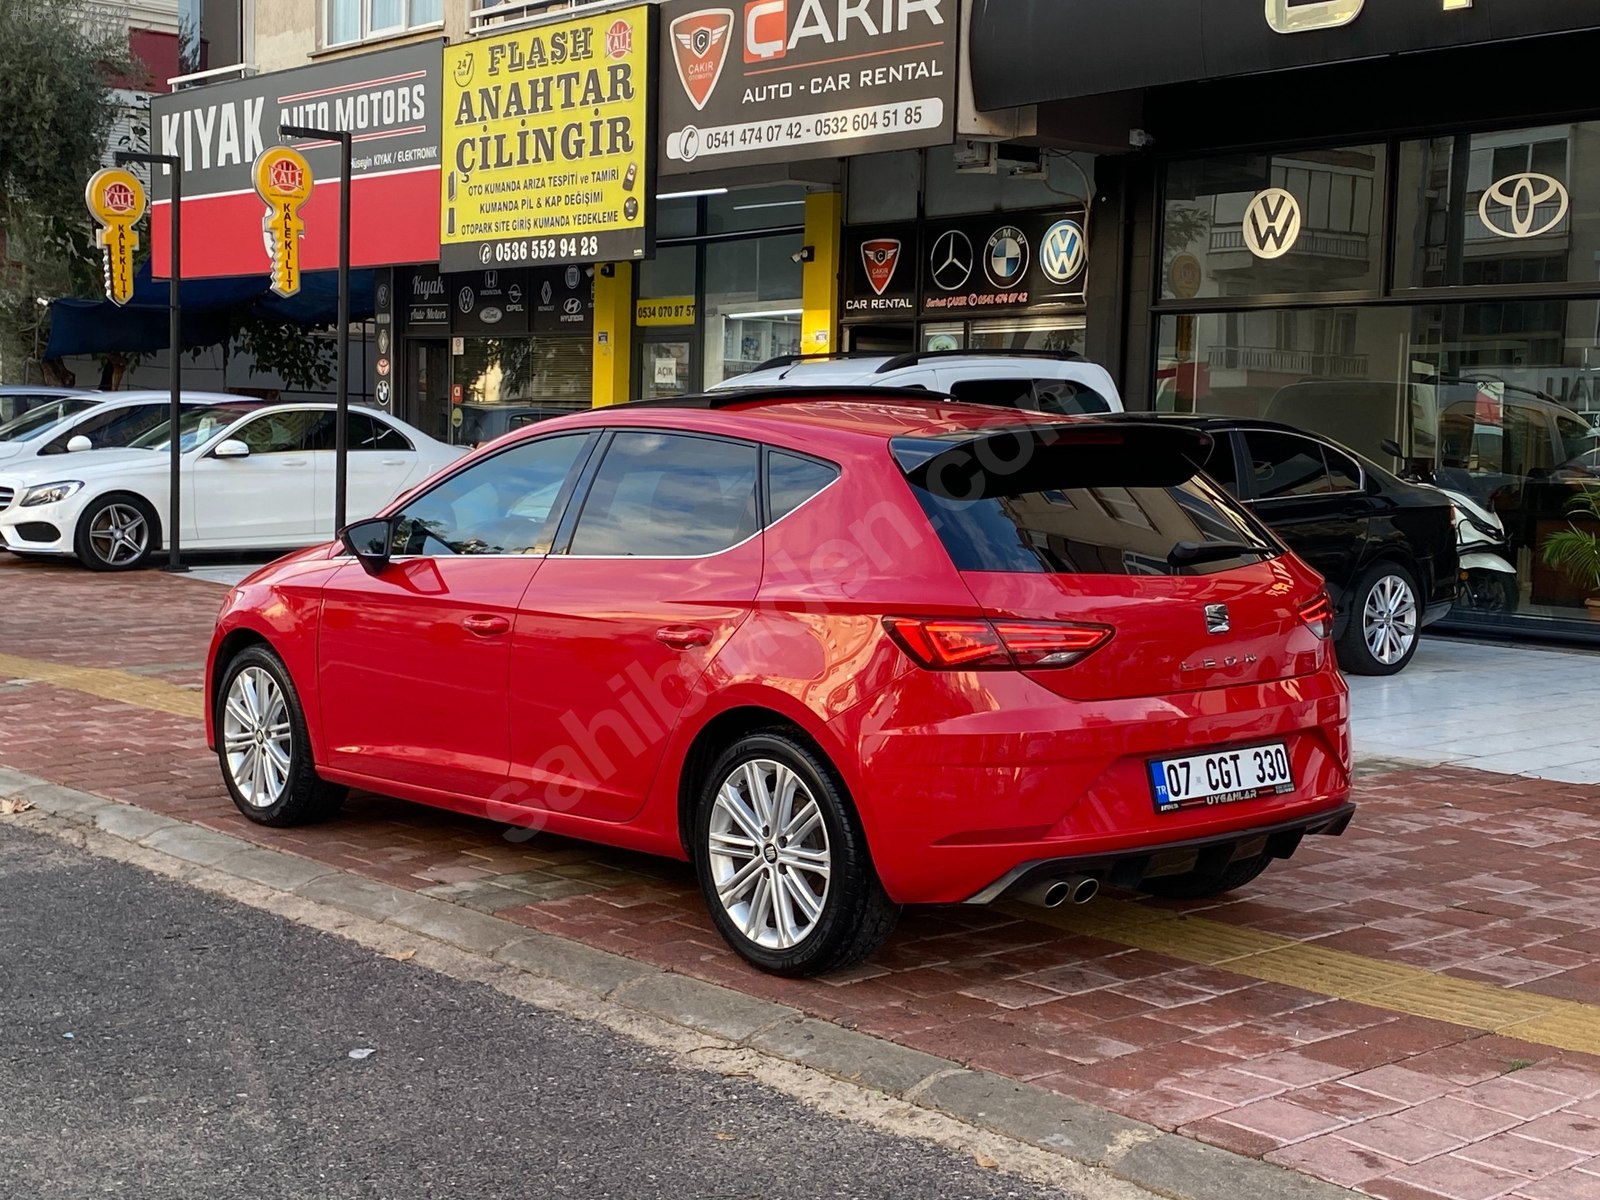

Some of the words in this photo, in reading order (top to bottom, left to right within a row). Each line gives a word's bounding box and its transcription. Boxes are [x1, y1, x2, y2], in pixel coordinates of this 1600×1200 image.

[488, 27, 593, 76] FLASH
[606, 31, 632, 52] KALE
[454, 63, 635, 126] ANAHTAR
[742, 82, 793, 104] AUTO
[810, 73, 851, 94] CAR
[859, 59, 944, 88] RENTAL
[335, 84, 425, 132] MOTORS
[161, 96, 265, 176] KIYAK
[707, 130, 735, 149] 0541
[740, 126, 763, 145] 474
[767, 124, 782, 142] 07
[785, 122, 802, 140] 42
[815, 116, 848, 137] 0532
[852, 111, 878, 132] 604
[883, 109, 899, 128] 51
[905, 106, 922, 125] 85
[456, 108, 634, 183] ÇİLİNGİR
[374, 152, 392, 167] KIYAK
[270, 167, 304, 188] KALE
[468, 184, 483, 197] OTO
[485, 180, 521, 195] KUMANDA
[523, 177, 546, 190] ARIZA
[548, 171, 578, 188] TESPİTİ
[580, 174, 589, 184] ve
[591, 165, 619, 183] TAMİRİ
[105, 191, 135, 208] KALE
[479, 200, 519, 214] KUMANDA
[521, 196, 534, 210] PİL
[536, 197, 542, 208] &
[545, 194, 562, 208] KAP
[564, 189, 603, 207] DEĞİŞİMİ
[461, 221, 493, 236] OTOPARK
[512, 217, 532, 232] GİRİŞ
[533, 215, 570, 229] KUMANDA
[572, 210, 619, 227] YEDEKLEME
[495, 243, 527, 262] 0536
[531, 239, 556, 260] 552
[560, 238, 576, 257] 94
[580, 235, 598, 256] 28
[506, 304, 524, 312] OPEL
[638, 306, 656, 319] 0534
[659, 305, 673, 318] 070
[674, 305, 684, 317] 87
[686, 304, 696, 316] 57
[846, 299, 867, 310] CAR
[871, 298, 913, 310] RENTAL
[657, 366, 674, 379] AÇIK
[1180, 653, 1257, 671] LEON
[1156, 785, 1168, 795] TR
[1166, 761, 1191, 798] 07
[1205, 754, 1243, 791] CGT
[1253, 748, 1287, 784] 330
